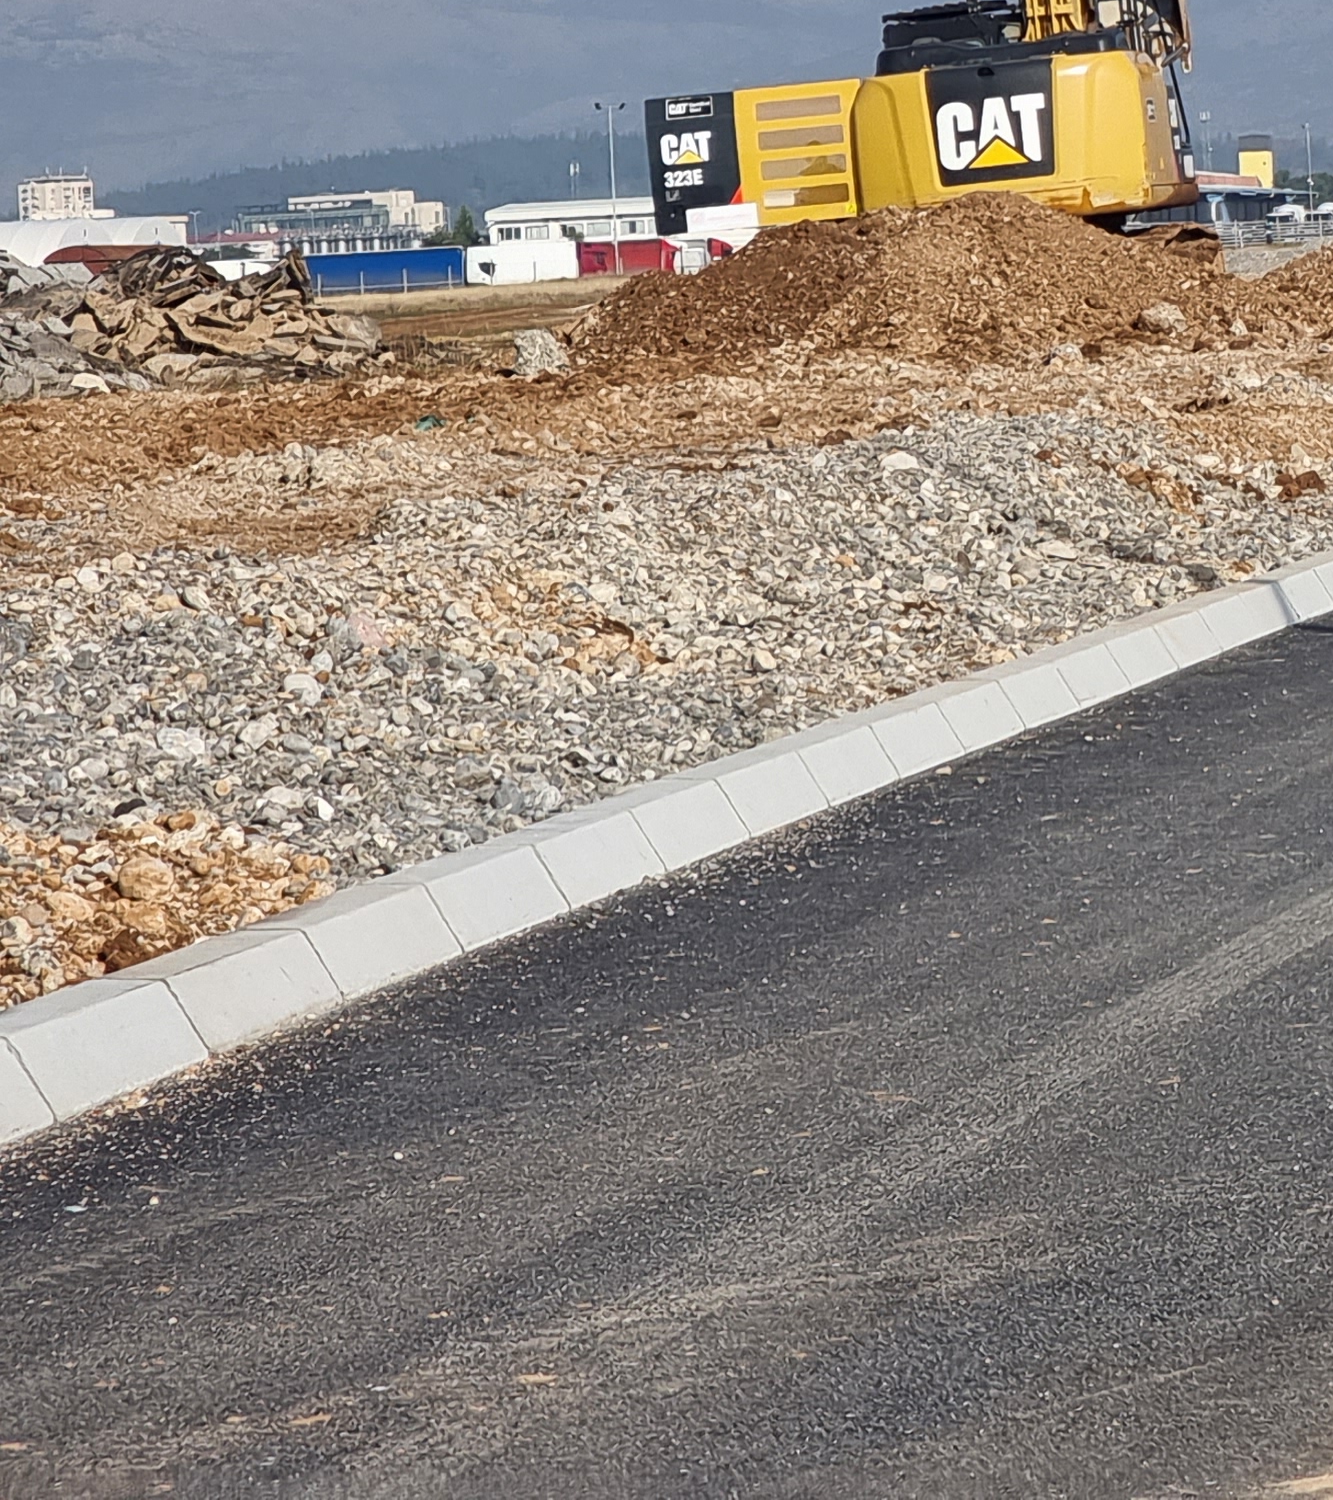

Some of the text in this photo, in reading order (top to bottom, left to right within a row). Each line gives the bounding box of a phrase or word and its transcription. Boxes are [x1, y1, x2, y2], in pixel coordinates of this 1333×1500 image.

[660, 131, 711, 165] CAT
[936, 92, 1045, 171] CAT
[664, 169, 704, 188] 323E
